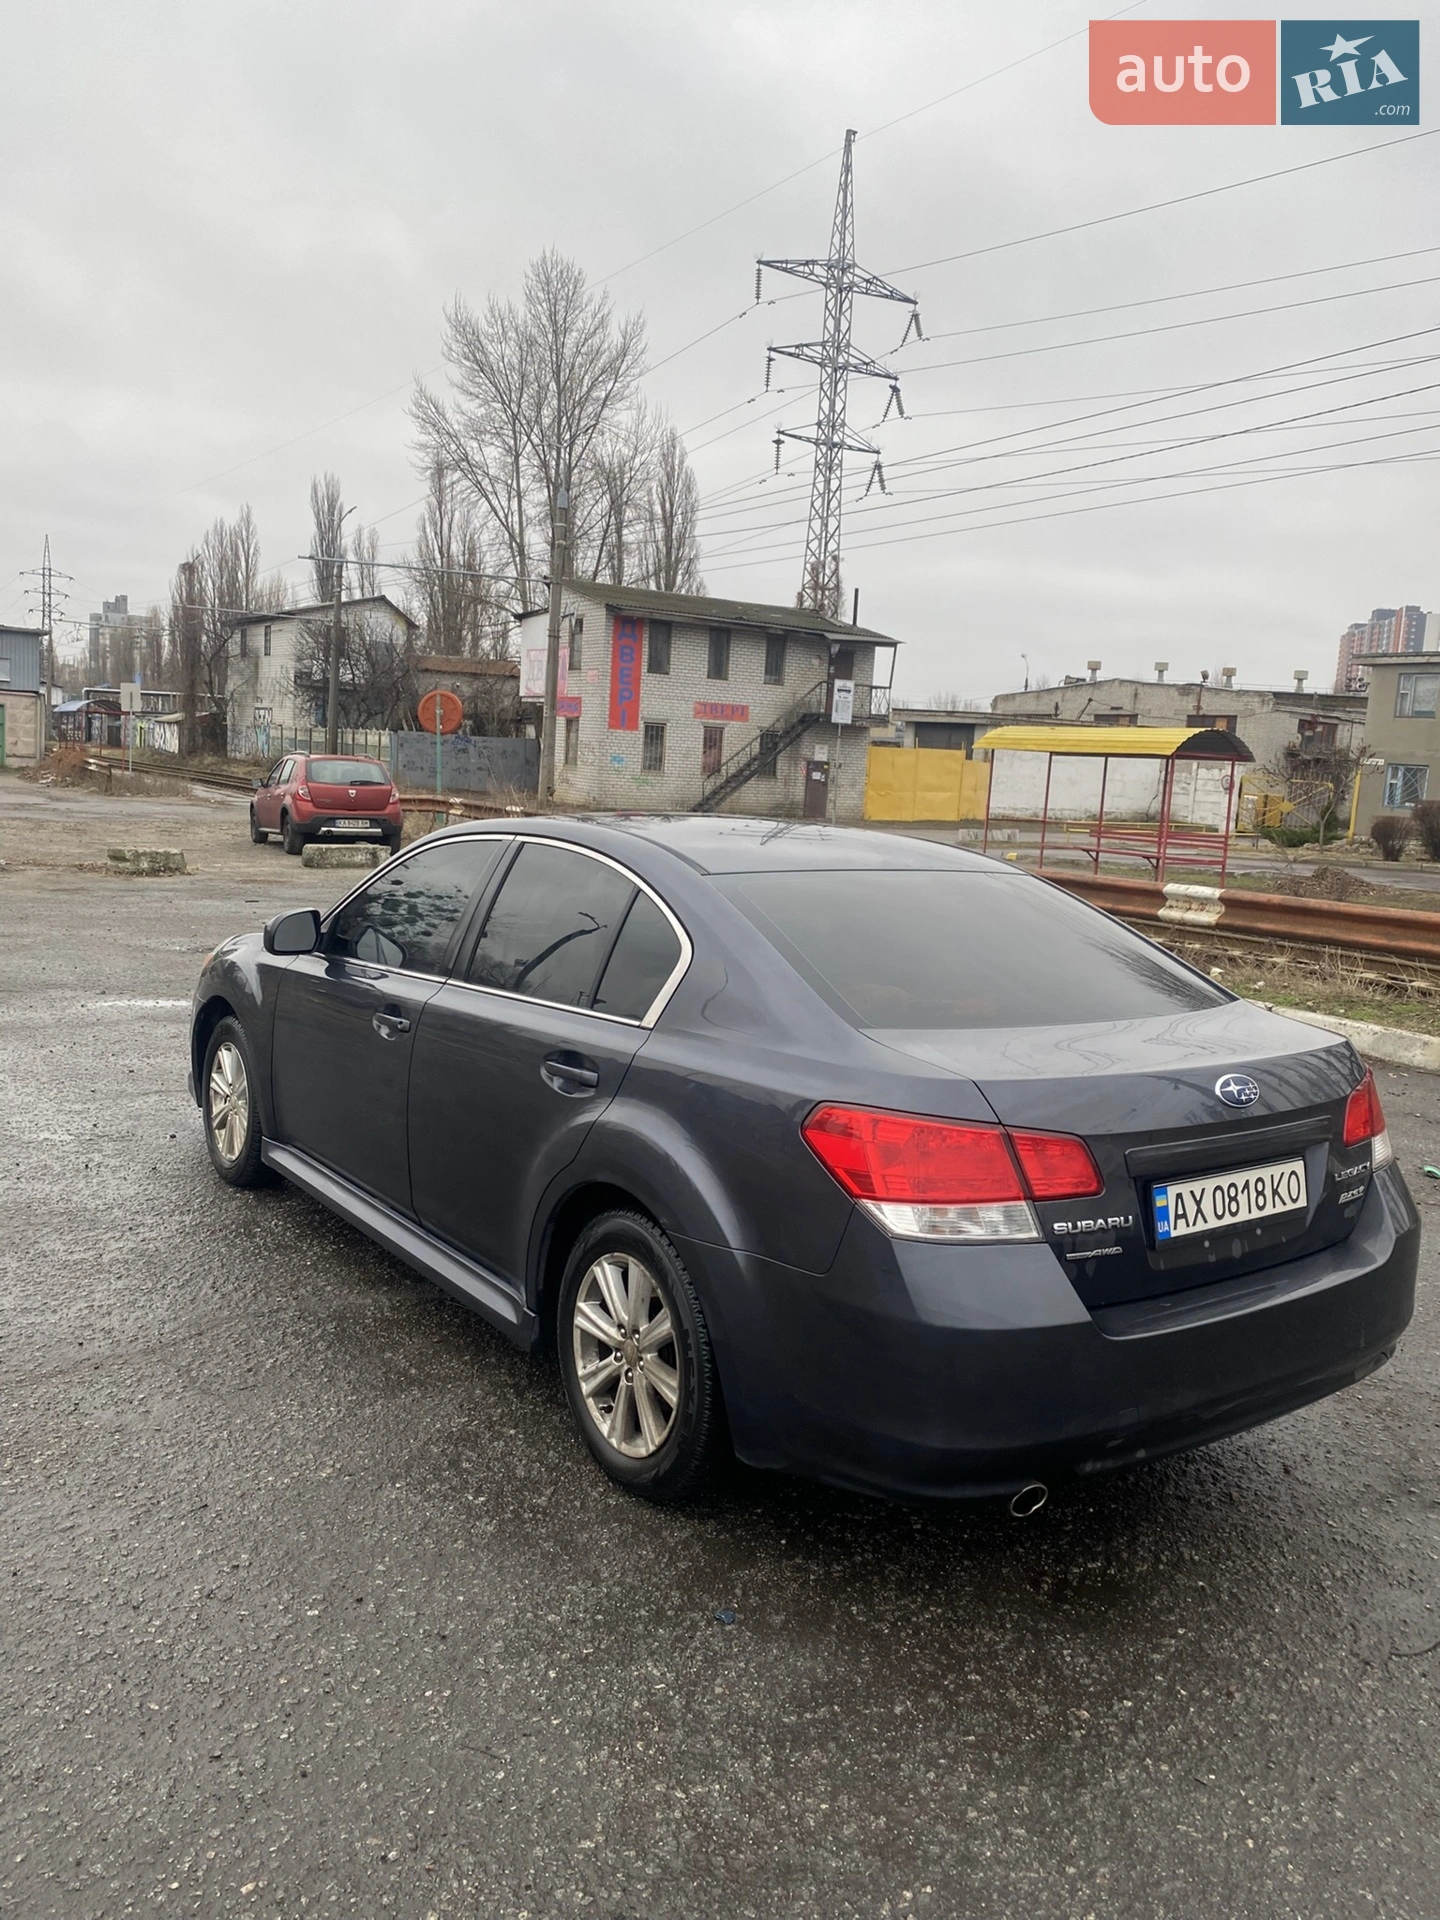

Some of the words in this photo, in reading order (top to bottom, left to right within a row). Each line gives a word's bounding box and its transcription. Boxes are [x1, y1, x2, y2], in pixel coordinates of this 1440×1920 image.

[617, 615, 637, 731] ДВЕРІ
[1052, 1215, 1133, 1235] SUBARU
[1157, 1220, 1170, 1234] UA
[1089, 1246, 1123, 1258] AWD
